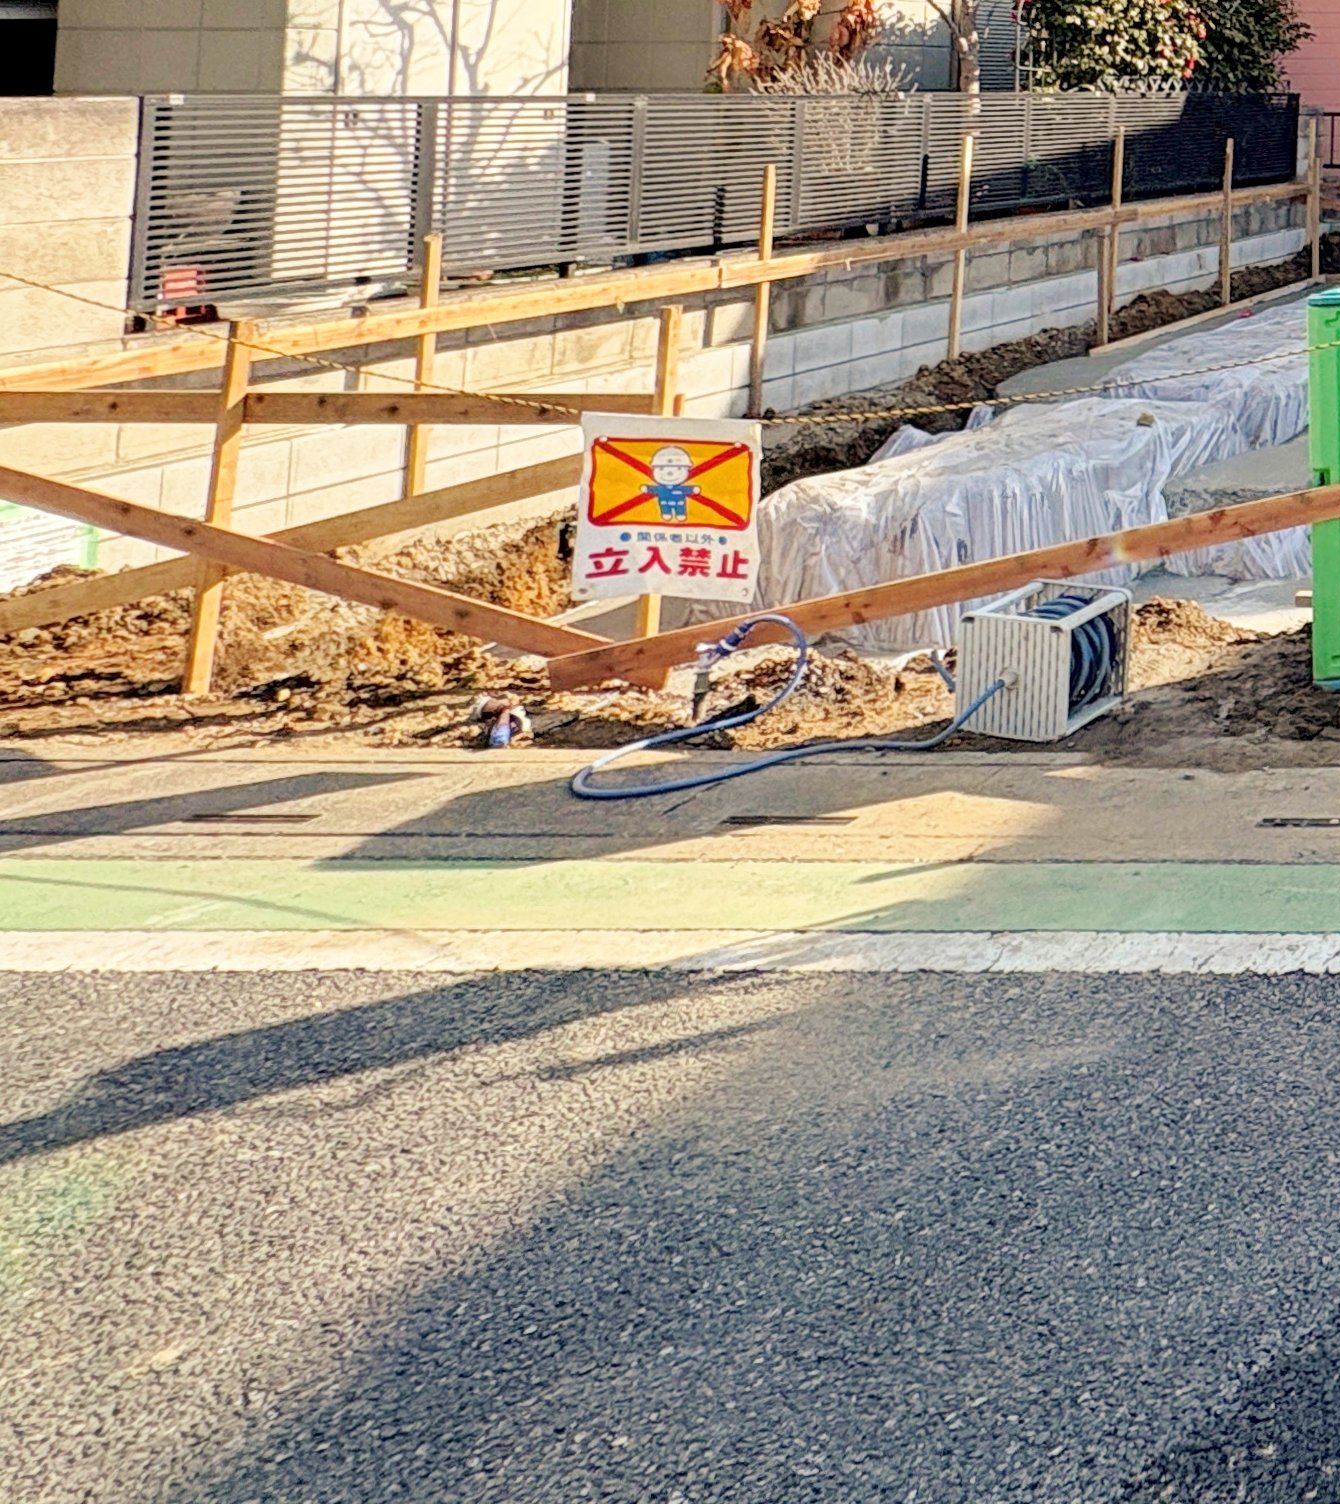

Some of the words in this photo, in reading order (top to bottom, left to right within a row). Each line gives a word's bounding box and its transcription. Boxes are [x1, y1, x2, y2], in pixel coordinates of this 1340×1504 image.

[637, 531, 715, 544] 関係者以外
[585, 546, 750, 580] 立入禁止
